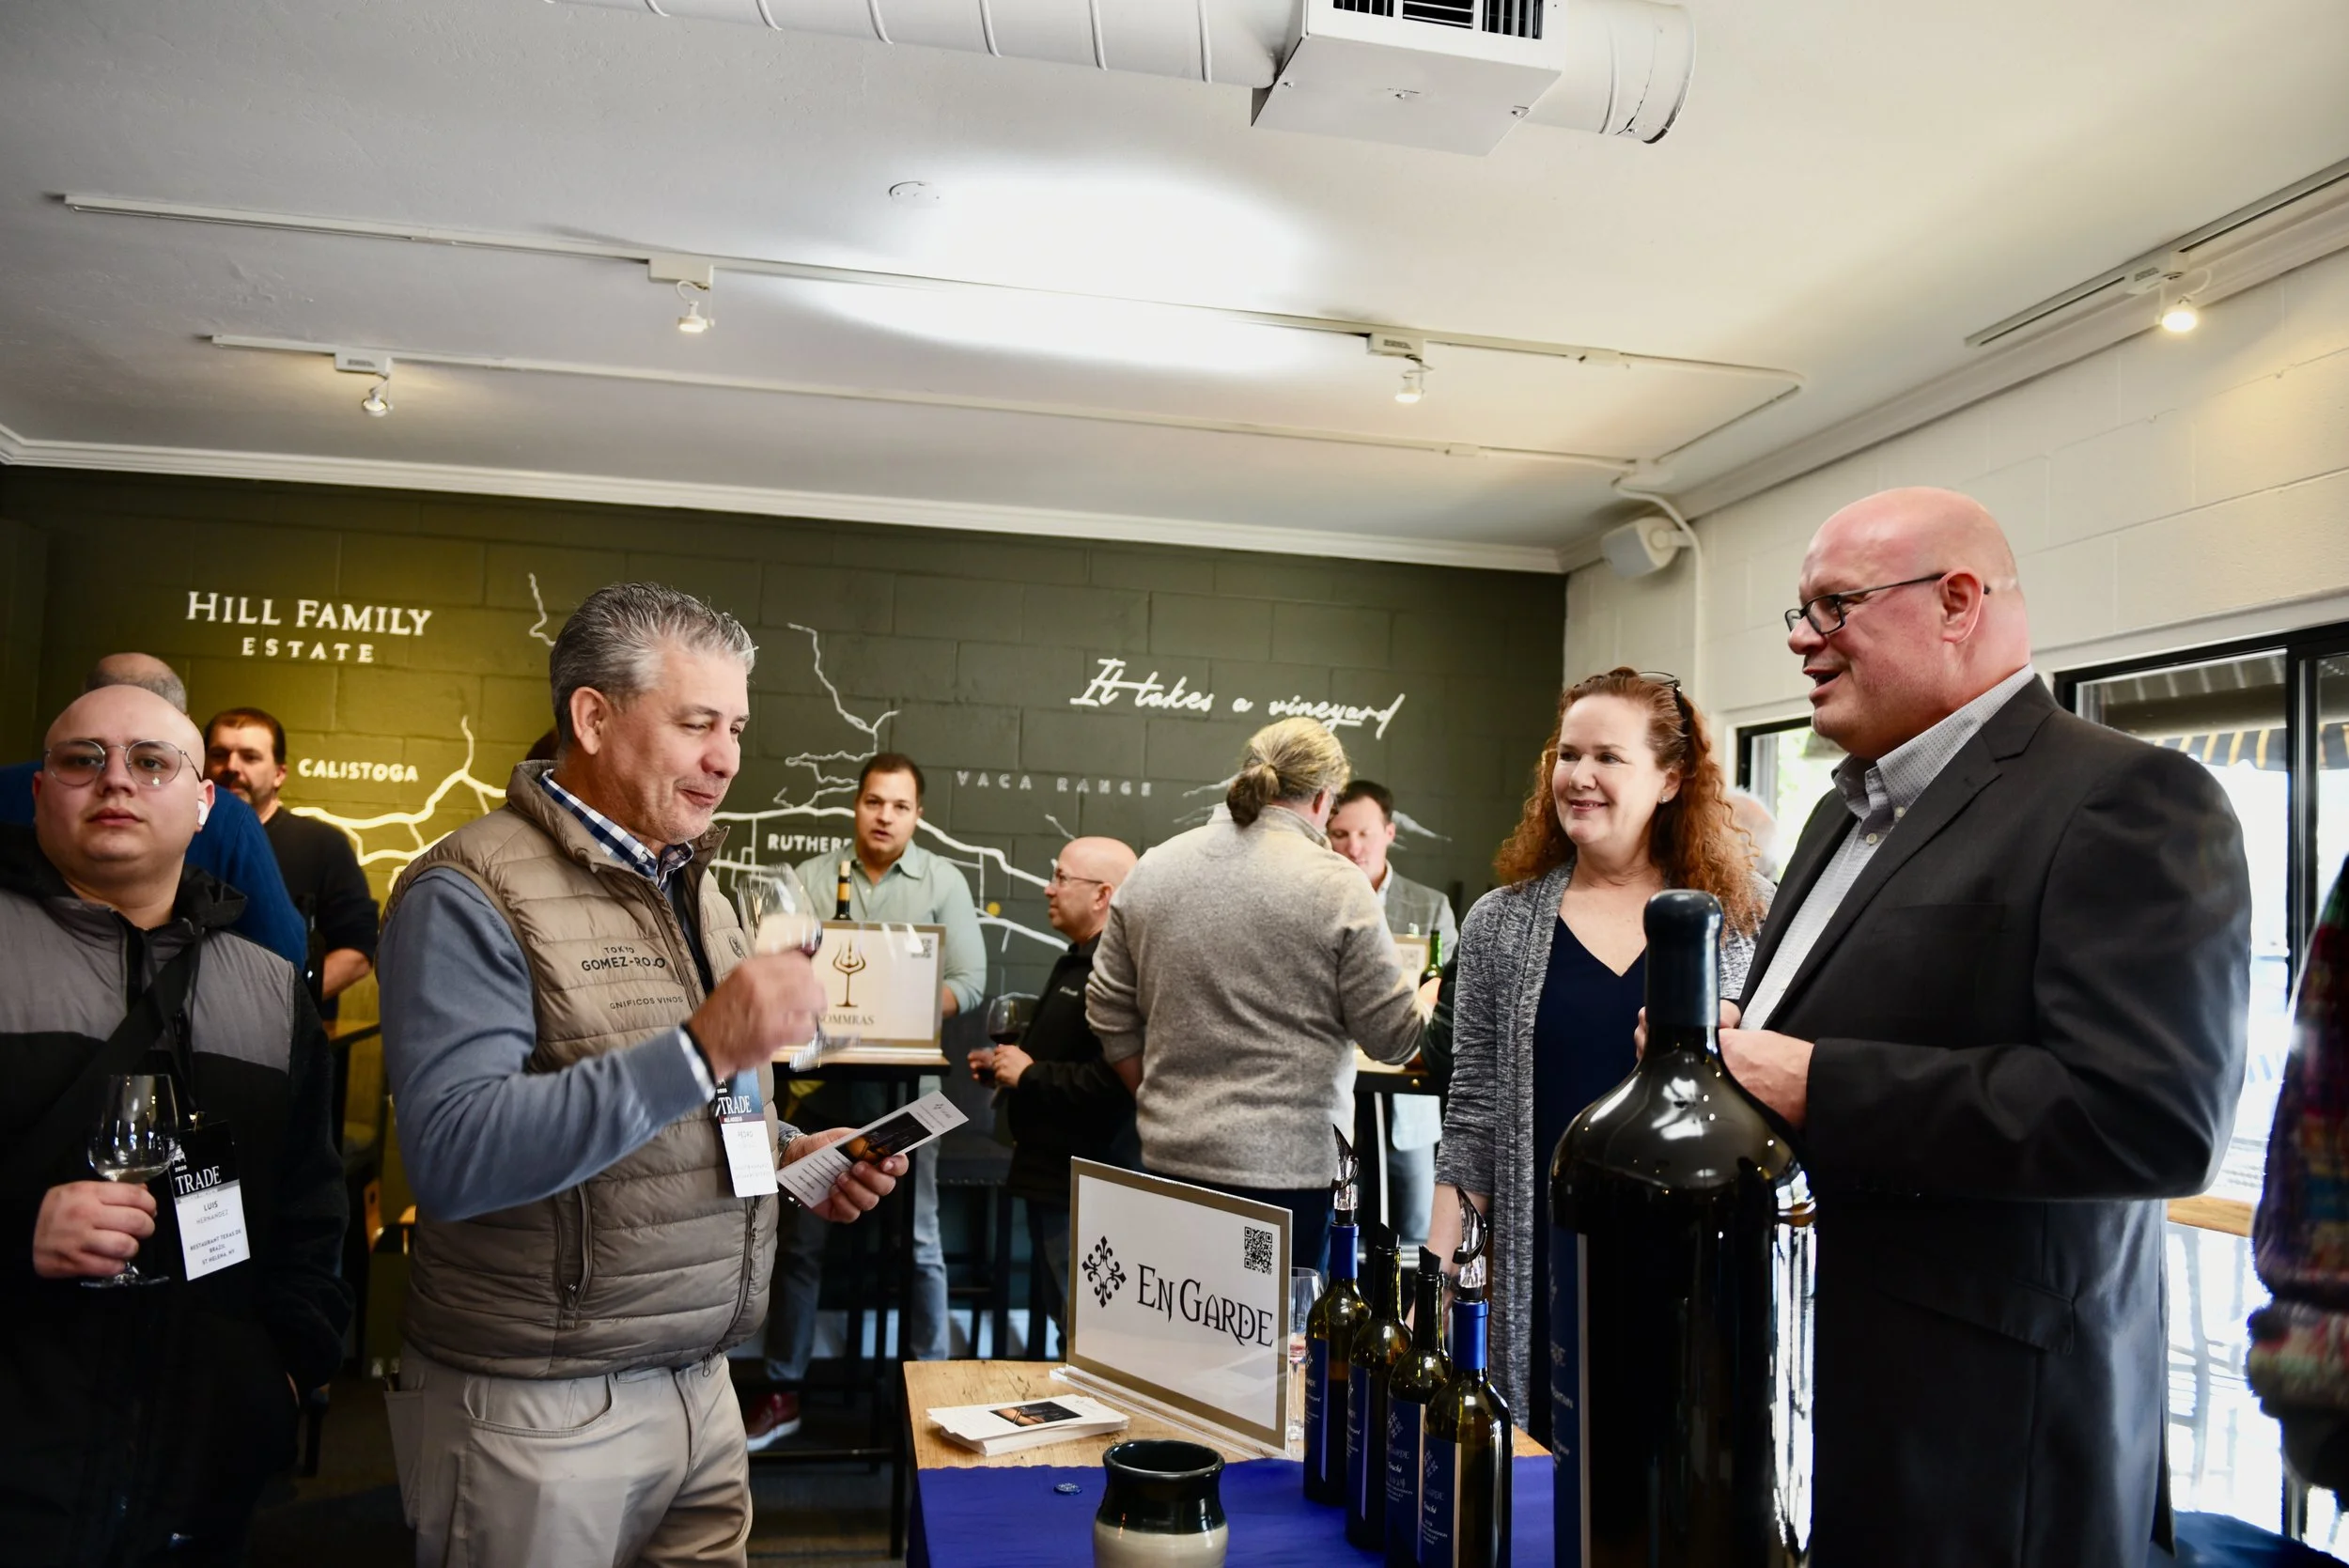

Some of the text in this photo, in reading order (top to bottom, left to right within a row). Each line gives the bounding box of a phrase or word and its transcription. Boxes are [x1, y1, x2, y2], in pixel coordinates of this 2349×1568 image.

[186, 591, 432, 637] HILL FAMILY
[241, 637, 374, 664] ESTATE
[1070, 658, 1406, 740] It takes a vineyard
[297, 757, 419, 783] CALISTOGA
[957, 770, 1152, 798] VACA RANGE
[603, 945, 635, 955] TOKYO
[657, 996, 684, 1004] VINOS
[718, 1095, 751, 1115] TRADE
[175, 1166, 222, 1194] TRADE
[203, 1201, 218, 1211] LUIS
[1179, 1278, 1273, 1347] GARDE
